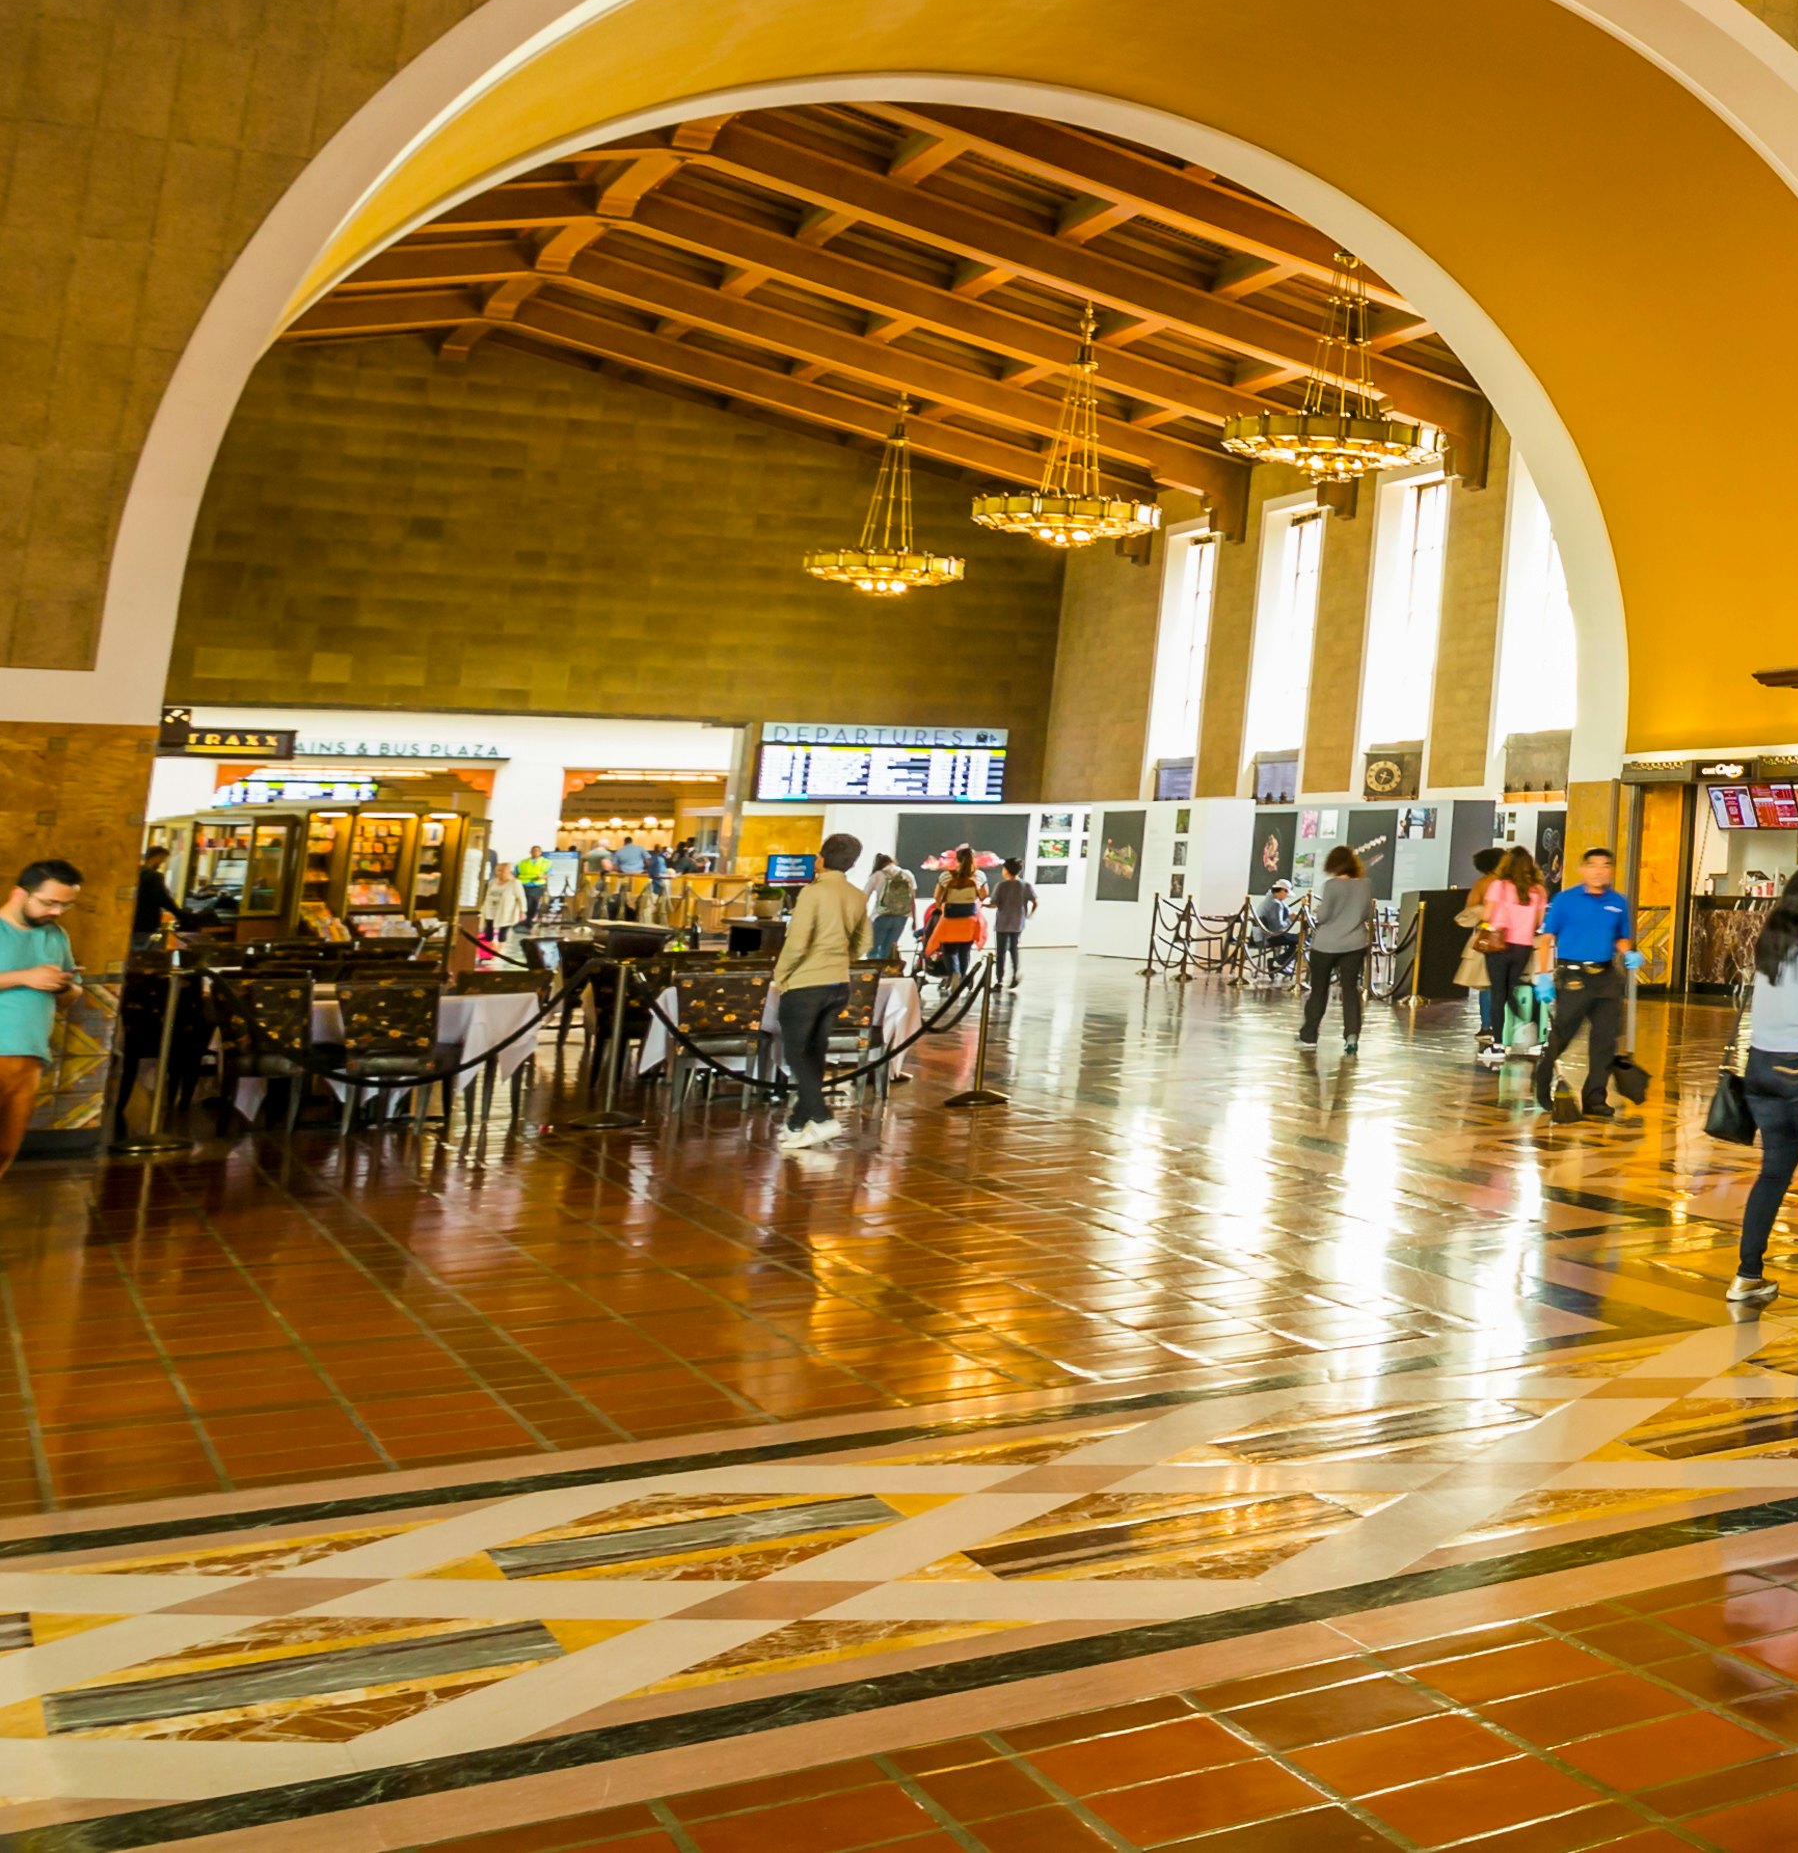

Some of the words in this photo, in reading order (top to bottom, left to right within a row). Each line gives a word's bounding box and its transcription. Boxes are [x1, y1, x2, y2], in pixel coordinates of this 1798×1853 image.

[774, 725, 963, 745] DEPARTURES
[295, 741, 347, 755] AINS
[356, 742, 368, 755] &
[380, 742, 420, 756] BUS
[430, 743, 500, 757] PLAZA
